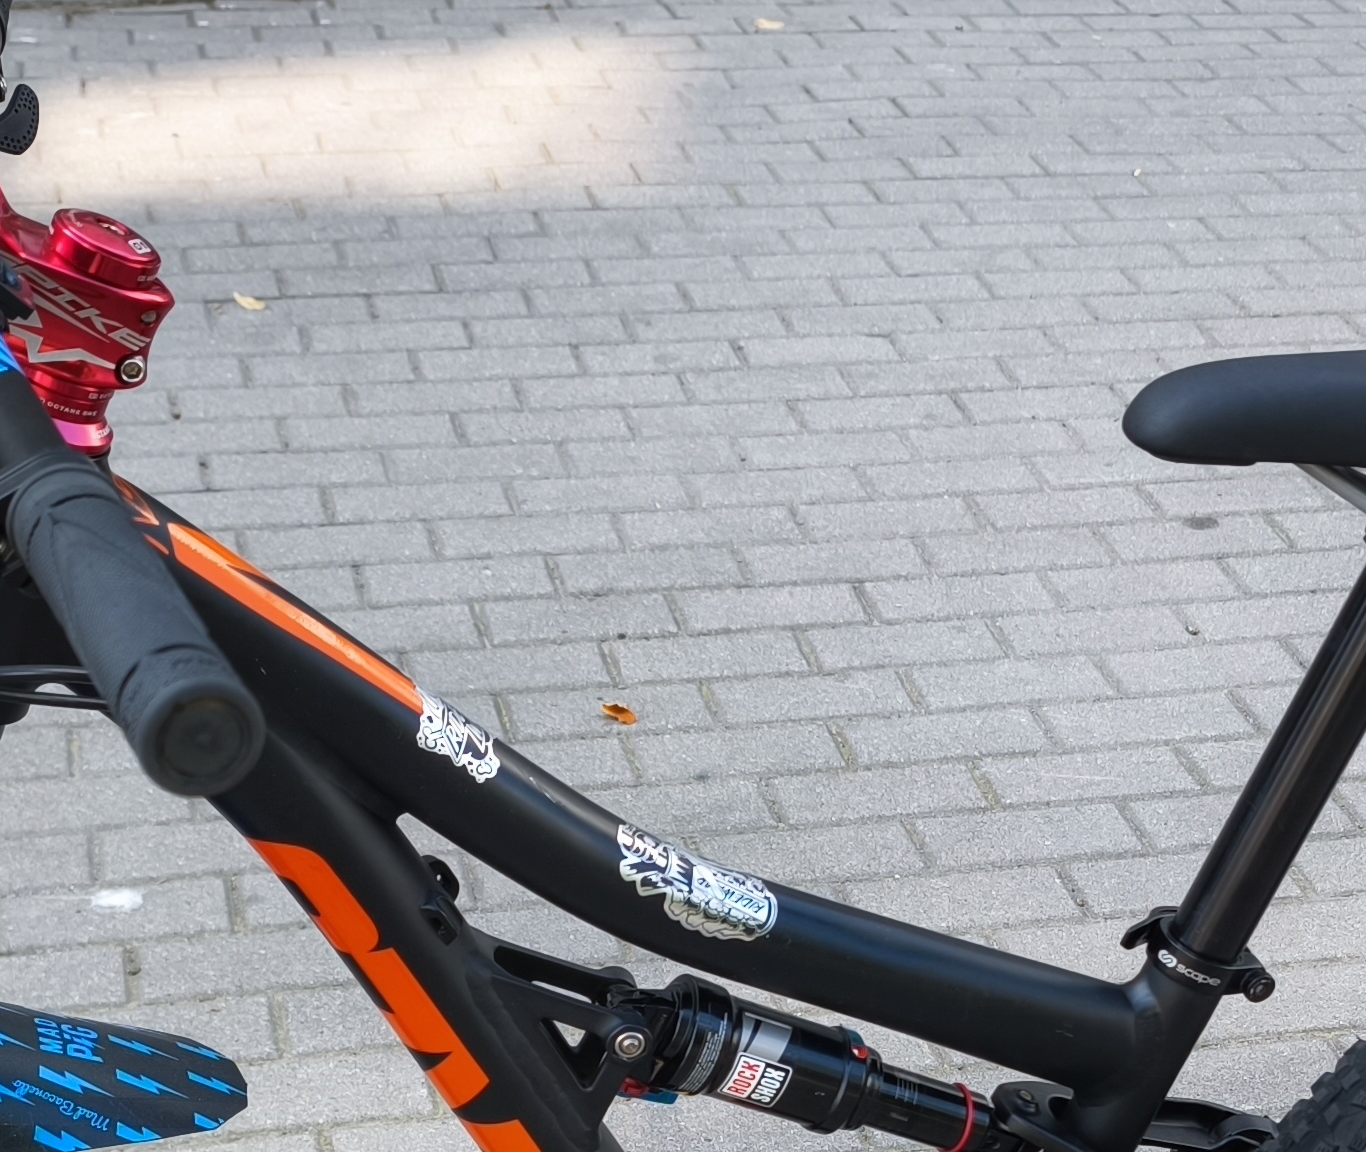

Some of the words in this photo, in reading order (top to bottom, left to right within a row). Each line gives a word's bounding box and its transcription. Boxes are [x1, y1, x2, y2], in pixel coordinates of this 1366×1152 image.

[34, 1017, 64, 1055] MAD
[726, 1061, 761, 1095] ROCK
[751, 1067, 785, 1103] SHOX
[73, 1105, 110, 1131] Mad
